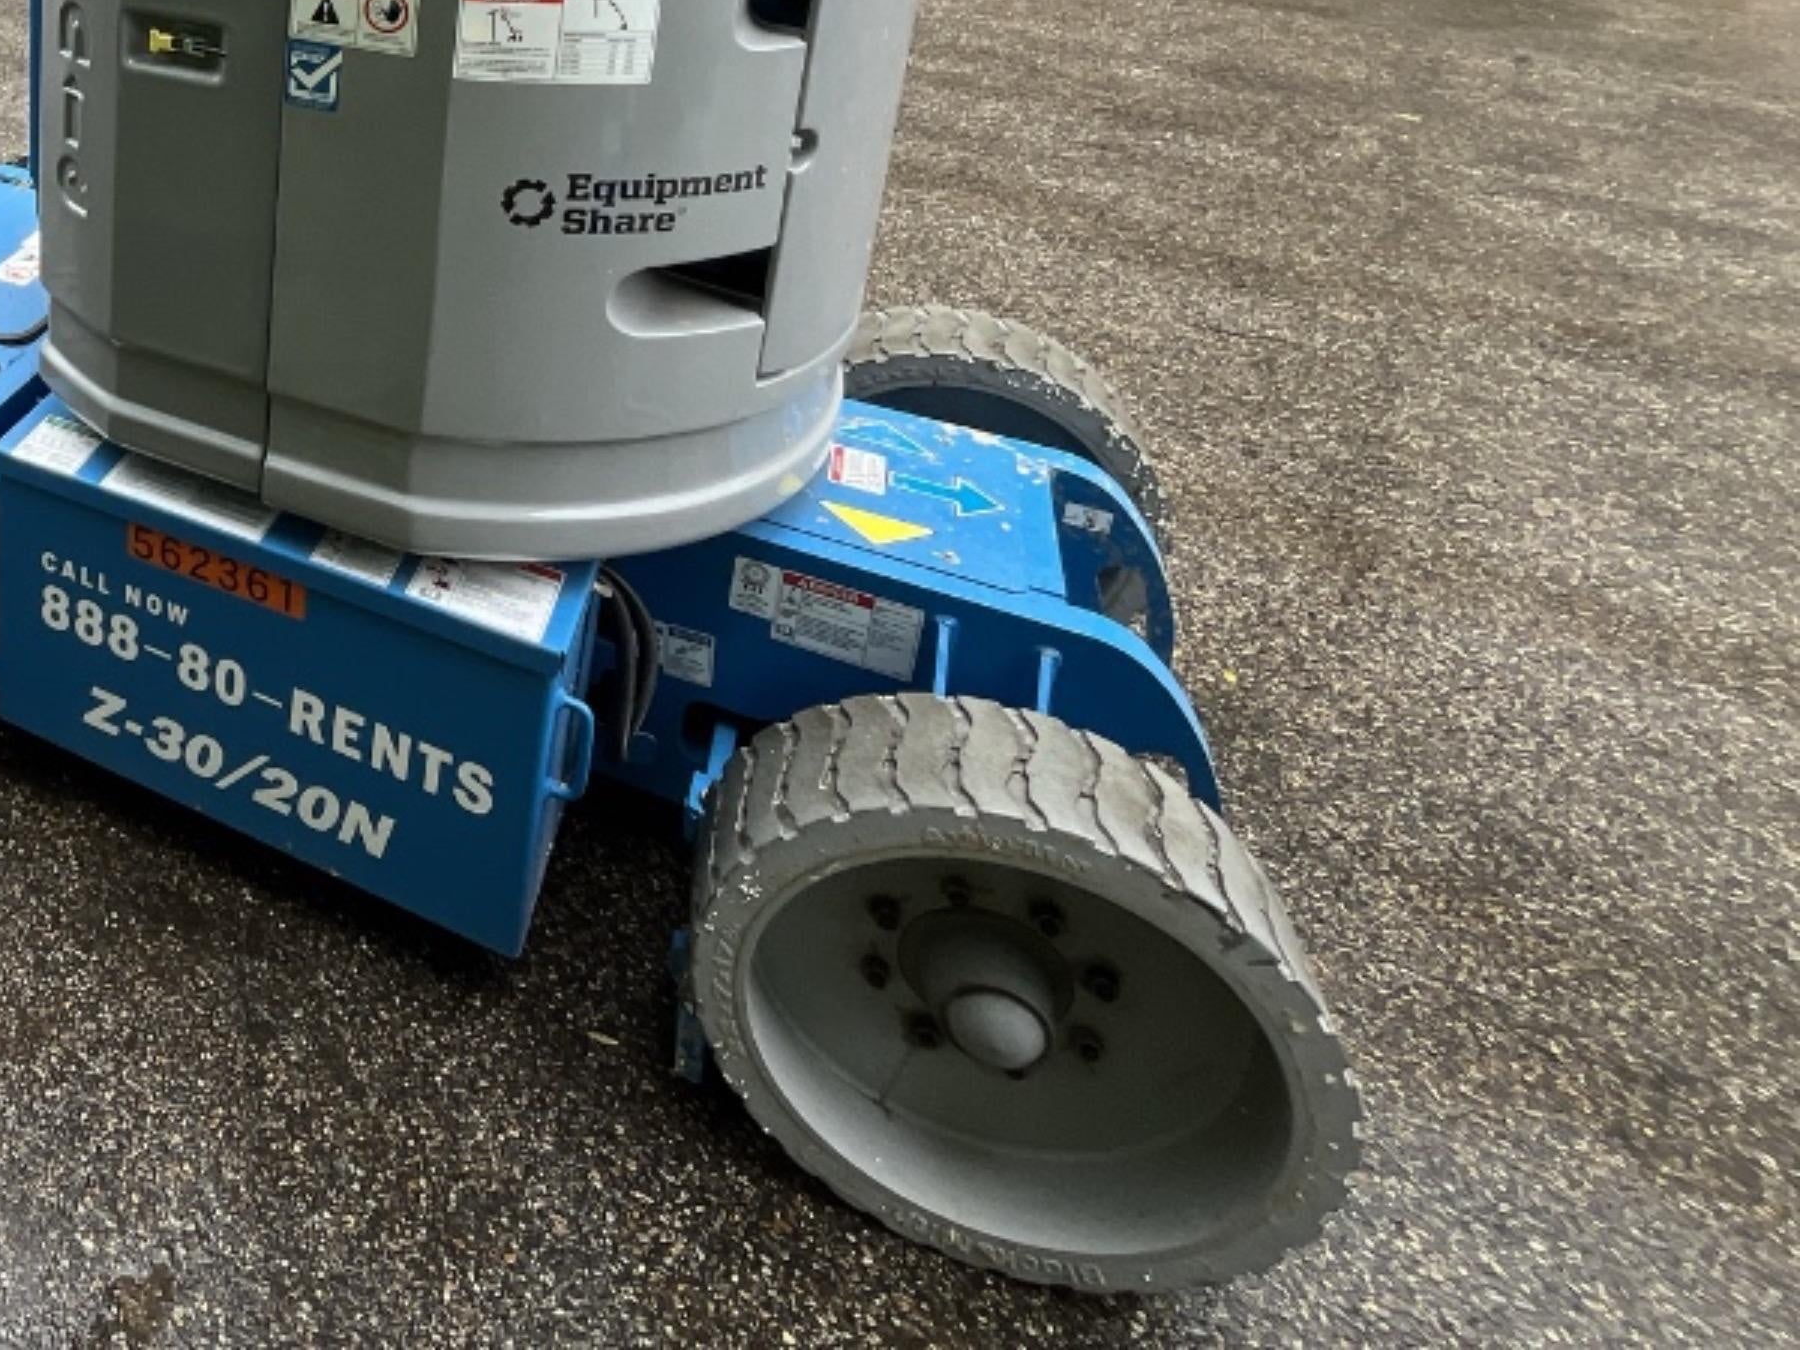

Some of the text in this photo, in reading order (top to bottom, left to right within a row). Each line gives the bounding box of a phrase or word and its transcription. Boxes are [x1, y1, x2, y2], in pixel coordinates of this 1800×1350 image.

[561, 208, 677, 235] Share
[565, 164, 769, 208] Equipment
[41, 551, 190, 628] CALL NOW
[131, 528, 298, 615] 562361
[41, 584, 494, 816] 888-80-RENTS
[83, 686, 396, 860] Z-30/20N
